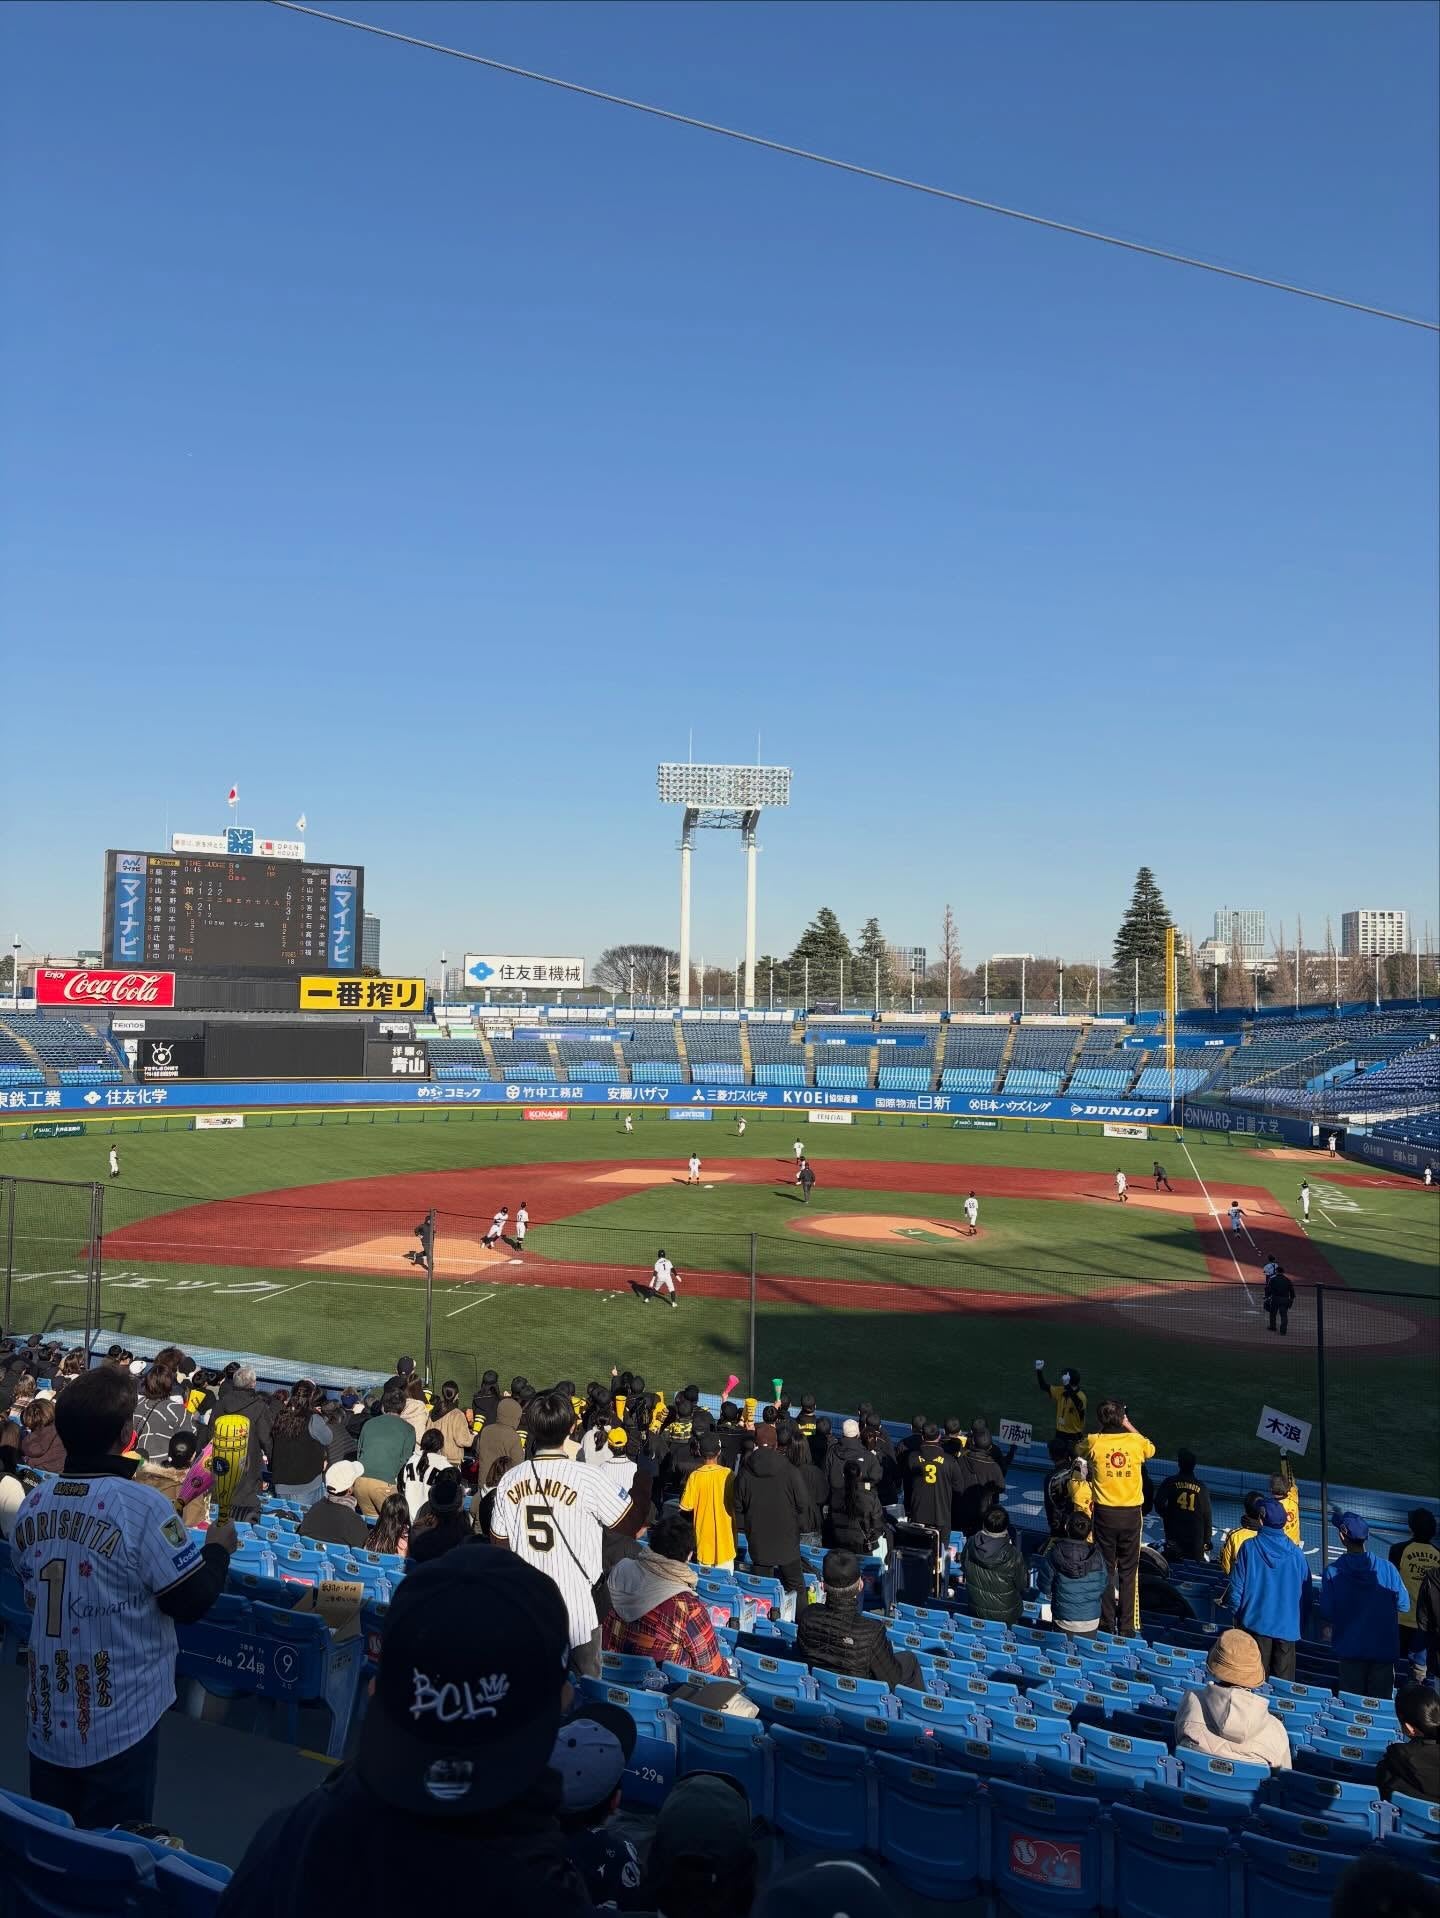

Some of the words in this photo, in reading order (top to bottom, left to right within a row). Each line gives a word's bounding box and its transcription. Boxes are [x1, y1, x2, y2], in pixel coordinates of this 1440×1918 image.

[120, 879, 141, 955] マイナビ
[333, 890, 353, 962] マイナビ
[45, 971, 66, 979] Enjoy
[499, 964, 581, 981] 住友重機械
[63, 972, 162, 1002] Coca-Cola
[307, 981, 417, 1007] 一番搾り
[391, 1057, 425, 1073] 青山
[105, 1088, 167, 1105] 住友化学
[417, 1086, 481, 1099] めちゃコミック
[523, 1086, 583, 1098] 竹中工務店
[608, 1087, 669, 1100] 安藤ハザマ
[707, 1089, 768, 1102] 三菱ガス化学
[875, 1097, 917, 1109] 国際物流
[918, 1095, 951, 1111] 日新
[980, 1099, 1051, 1113] 日本ハウズイング
[1085, 1105, 1159, 1117] DUNLOP
[528, 1110, 563, 1119] KONAMI
[1184, 1107, 1232, 1130] ONWARD
[1236, 1118, 1279, 1134] 白大学
[1265, 1417, 1302, 1444] 木浪
[925, 1464, 937, 1484] 3
[507, 1478, 578, 1507] CHIKAMOTO
[1177, 1491, 1196, 1512] 41
[526, 1504, 556, 1553] 5
[39, 1558, 68, 1638] 1
[282, 1654, 293, 1673] 9
[409, 1667, 497, 1722] BCL
